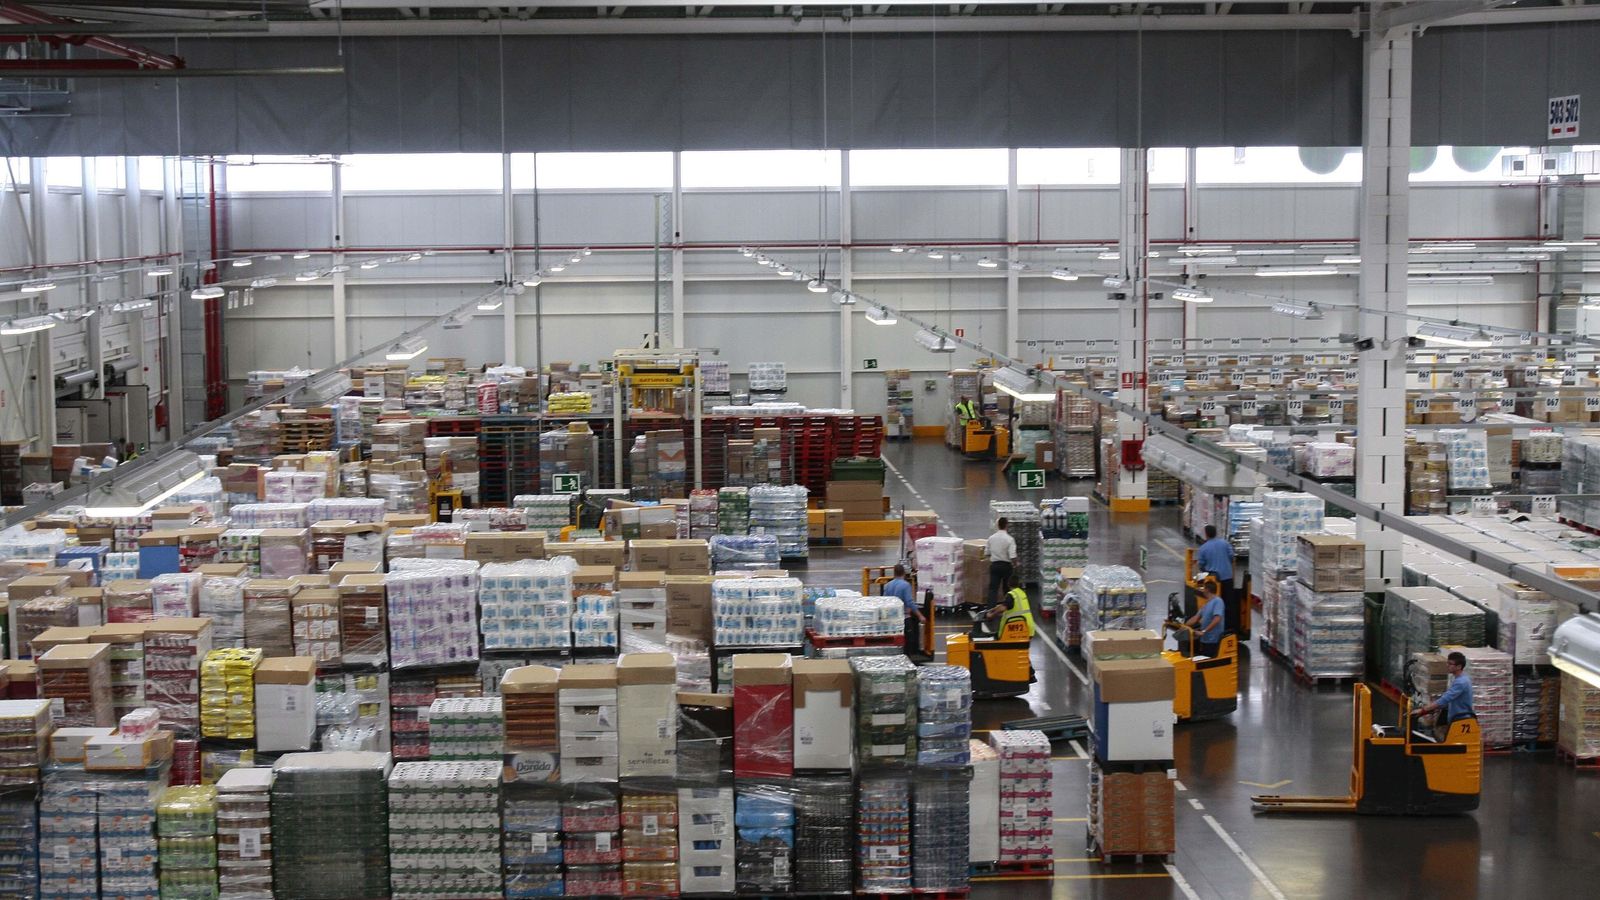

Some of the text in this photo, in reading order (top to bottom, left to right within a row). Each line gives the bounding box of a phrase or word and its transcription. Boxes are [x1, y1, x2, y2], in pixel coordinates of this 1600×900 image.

[1550, 98, 1578, 124] 503 502
[1203, 402, 1215, 410] 075
[1243, 402, 1256, 410] 074
[1289, 401, 1301, 409] 073
[1330, 401, 1342, 409] 072
[1416, 400, 1428, 408] 070
[1461, 399, 1473, 408] 069
[1501, 398, 1513, 407] 068
[1546, 398, 1559, 407] 067
[1587, 397, 1599, 406] 066
[1008, 624, 1024, 632] M92
[1461, 724, 1471, 734] 72
[628, 757, 670, 766] servilletas
[516, 761, 552, 773] Dorada
